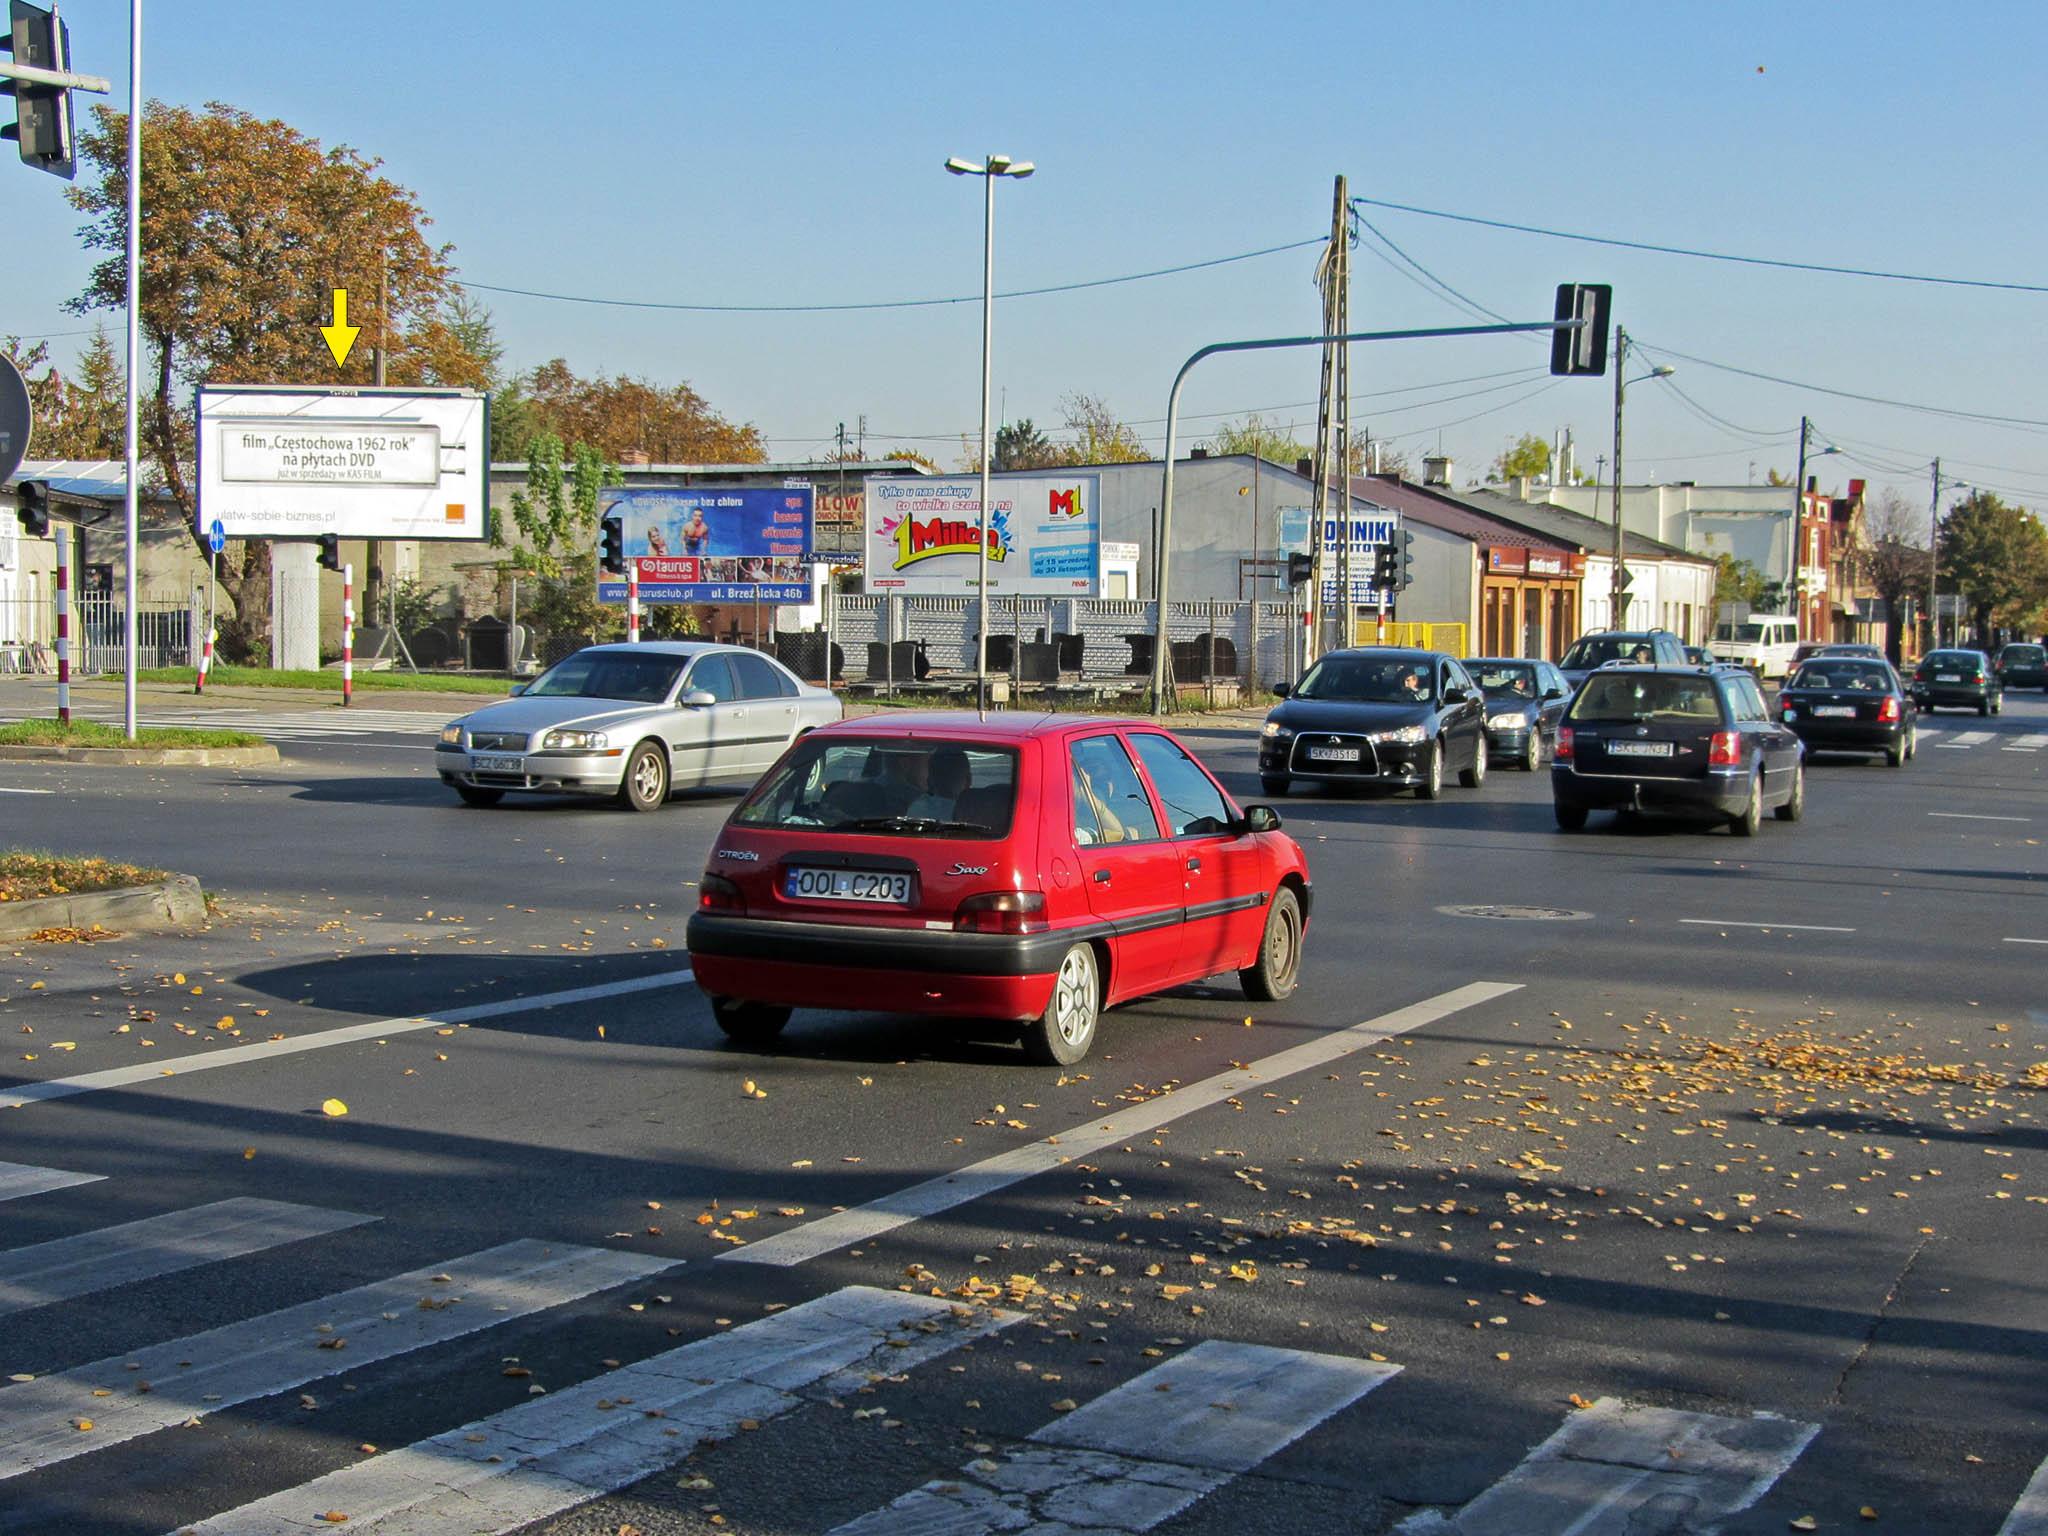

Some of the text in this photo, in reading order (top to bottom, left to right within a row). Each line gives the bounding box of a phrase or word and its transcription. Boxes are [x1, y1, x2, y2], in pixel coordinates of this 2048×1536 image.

[242, 435, 267, 448] film
[358, 438, 385, 450] 1962
[283, 453, 375, 468] na płytach DVD
[347, 470, 362, 479] KAS
[363, 471, 382, 479] FILM
[879, 486, 905, 498] Tylko
[915, 488, 933, 497] nas
[936, 485, 971, 498] zakupy
[896, 501, 910, 511] to
[912, 499, 950, 511] wielka
[997, 501, 1013, 511] na
[1050, 485, 1083, 519] M1
[656, 560, 693, 573] taurus
[711, 587, 803, 599] ul. Brzeźicka 46b
[944, 861, 988, 877] Saxo
[851, 874, 906, 900] C203
